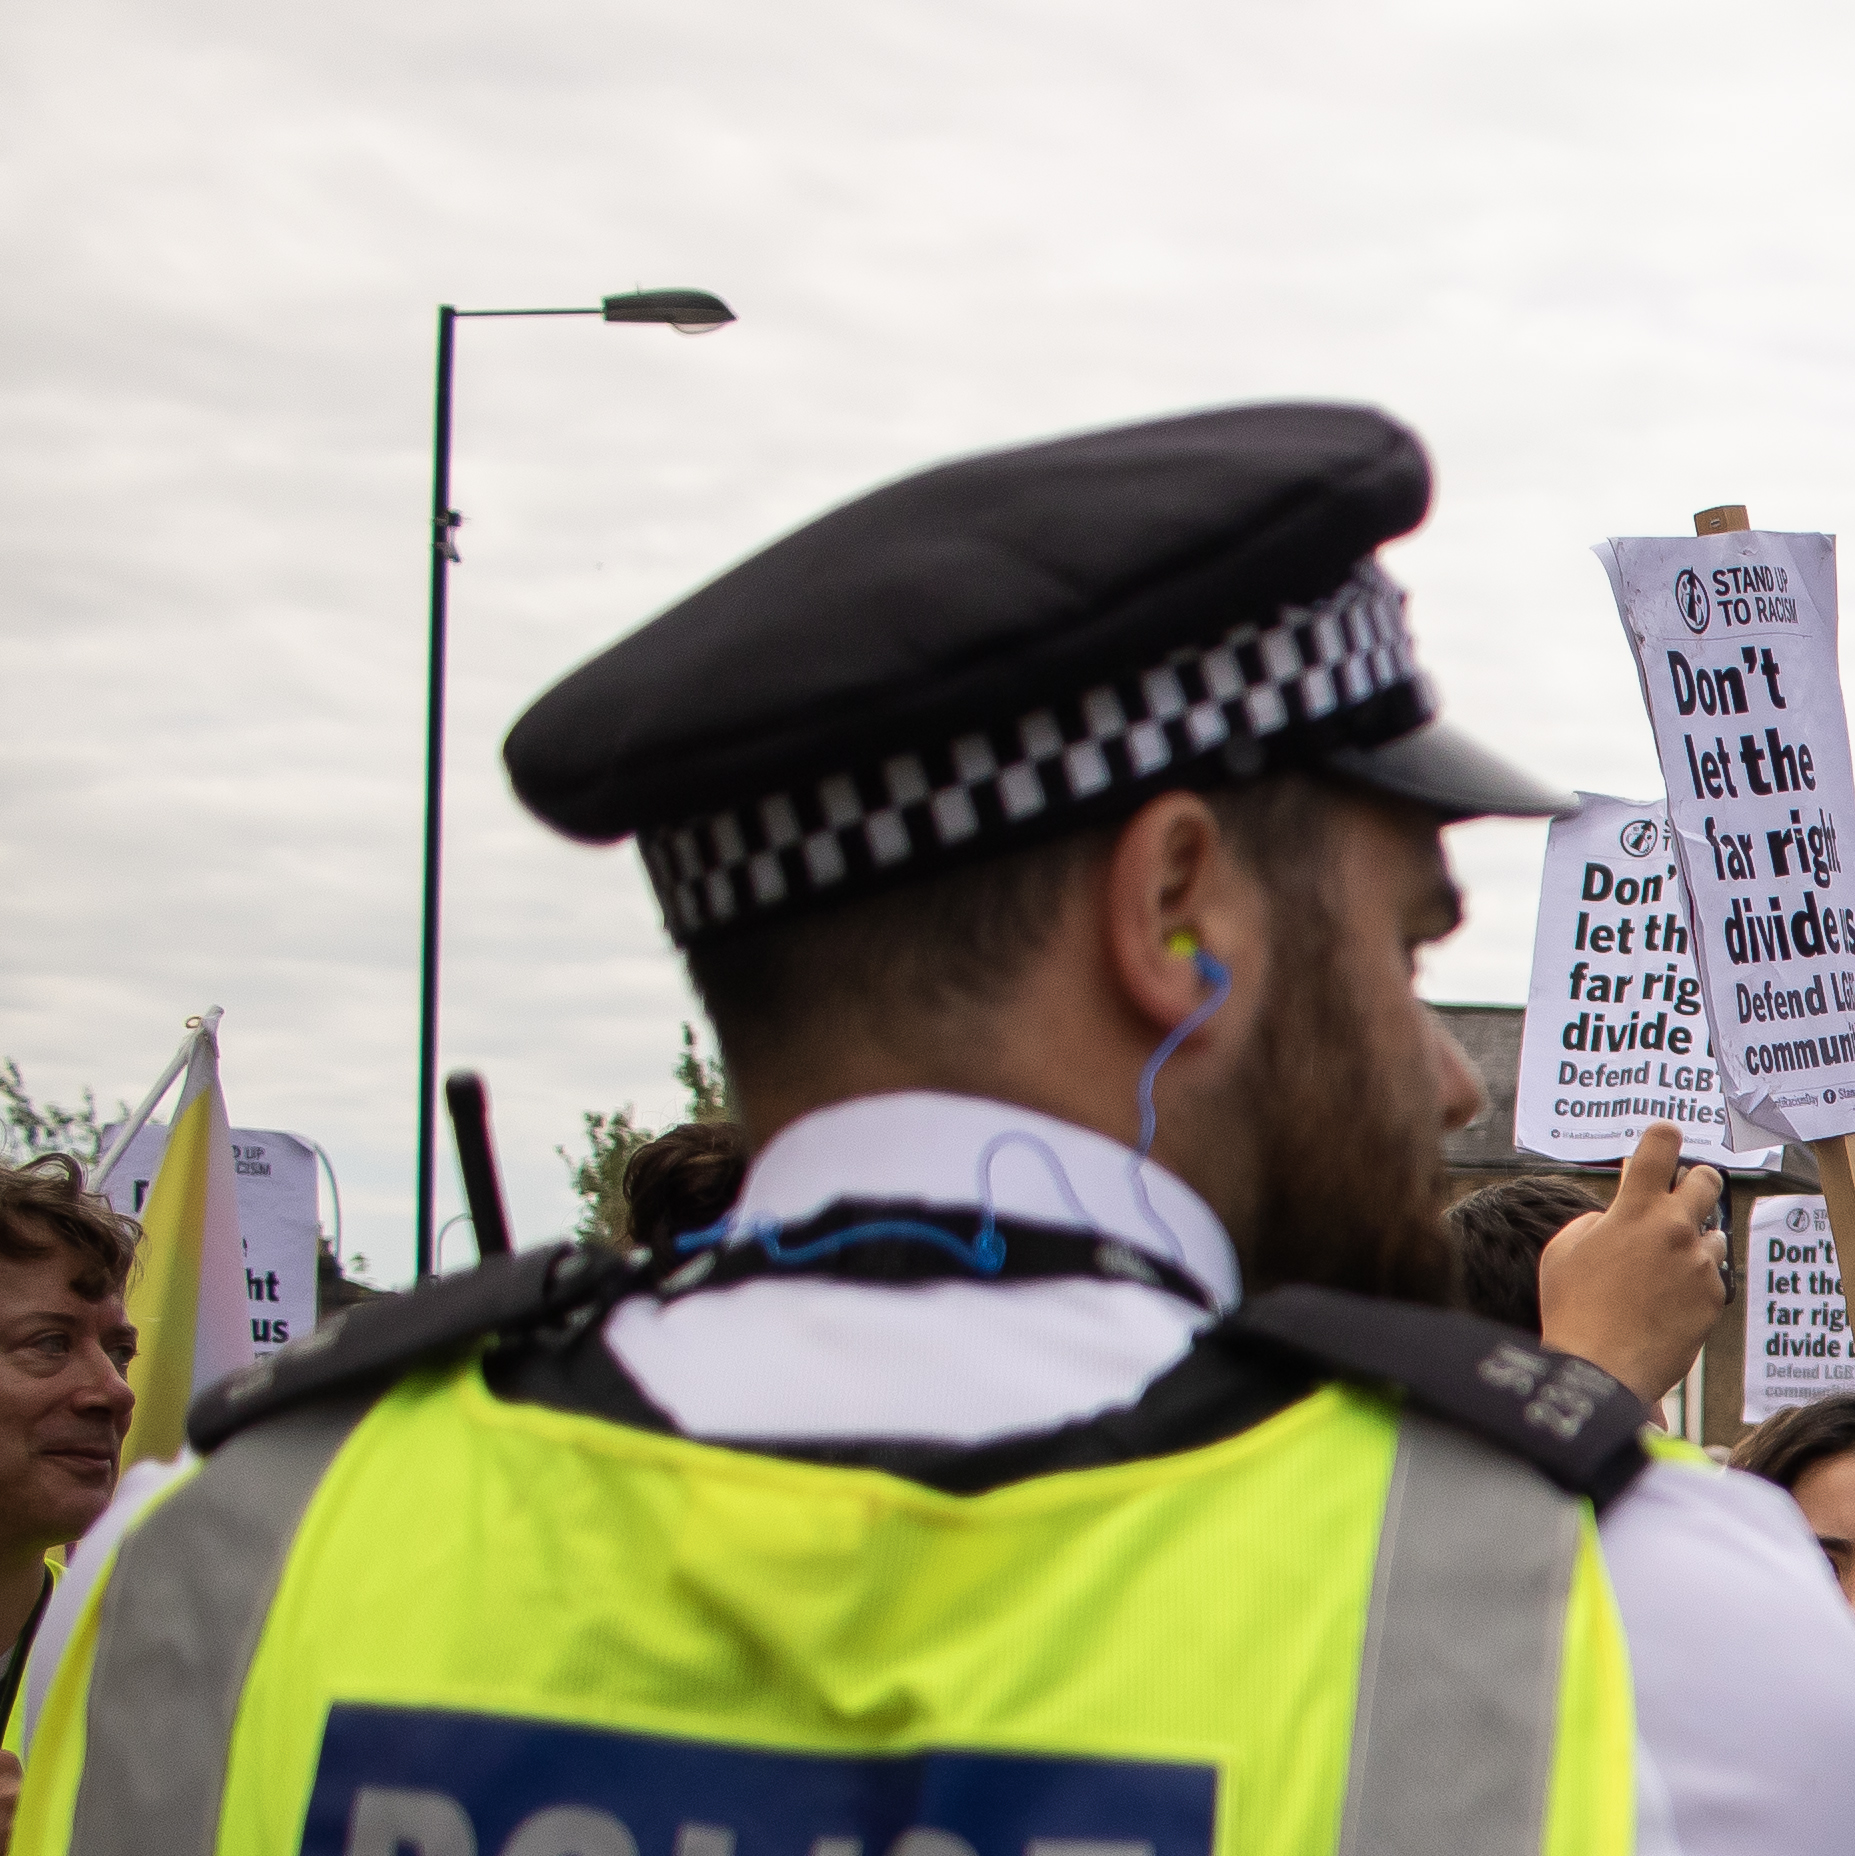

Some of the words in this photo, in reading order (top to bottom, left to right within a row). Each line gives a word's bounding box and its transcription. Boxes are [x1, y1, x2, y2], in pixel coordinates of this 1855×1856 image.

[1712, 565, 1774, 597] STAND
[1774, 566, 1788, 593] UP
[1717, 598, 1751, 627] TO
[1755, 597, 1799, 624] RACISM
[1684, 733, 1739, 800] let
[1739, 727, 1817, 796] the
[1705, 816, 1756, 881] far
[1766, 807, 1842, 889] right
[1582, 862, 1677, 905] Don'
[1574, 911, 1635, 955] let
[1645, 913, 1688, 955] th
[1724, 890, 1840, 966] divide
[1569, 961, 1634, 1003] far
[1642, 963, 1701, 1015] rig
[1735, 974, 1828, 1024] Defend
[1562, 1011, 1693, 1055] divide
[1558, 1060, 1651, 1088] Defend
[1659, 1062, 1724, 1093] LGB
[1554, 1095, 1726, 1126] communities
[245, 1146, 265, 1160] UP
[1766, 1269, 1801, 1294] let
[1808, 1270, 1845, 1295] the
[251, 1318, 289, 1344] us
[1766, 1300, 1804, 1325] far
[1811, 1301, 1850, 1332] rig
[1765, 1332, 1841, 1357] divide
[1766, 1363, 1820, 1379] Defend
